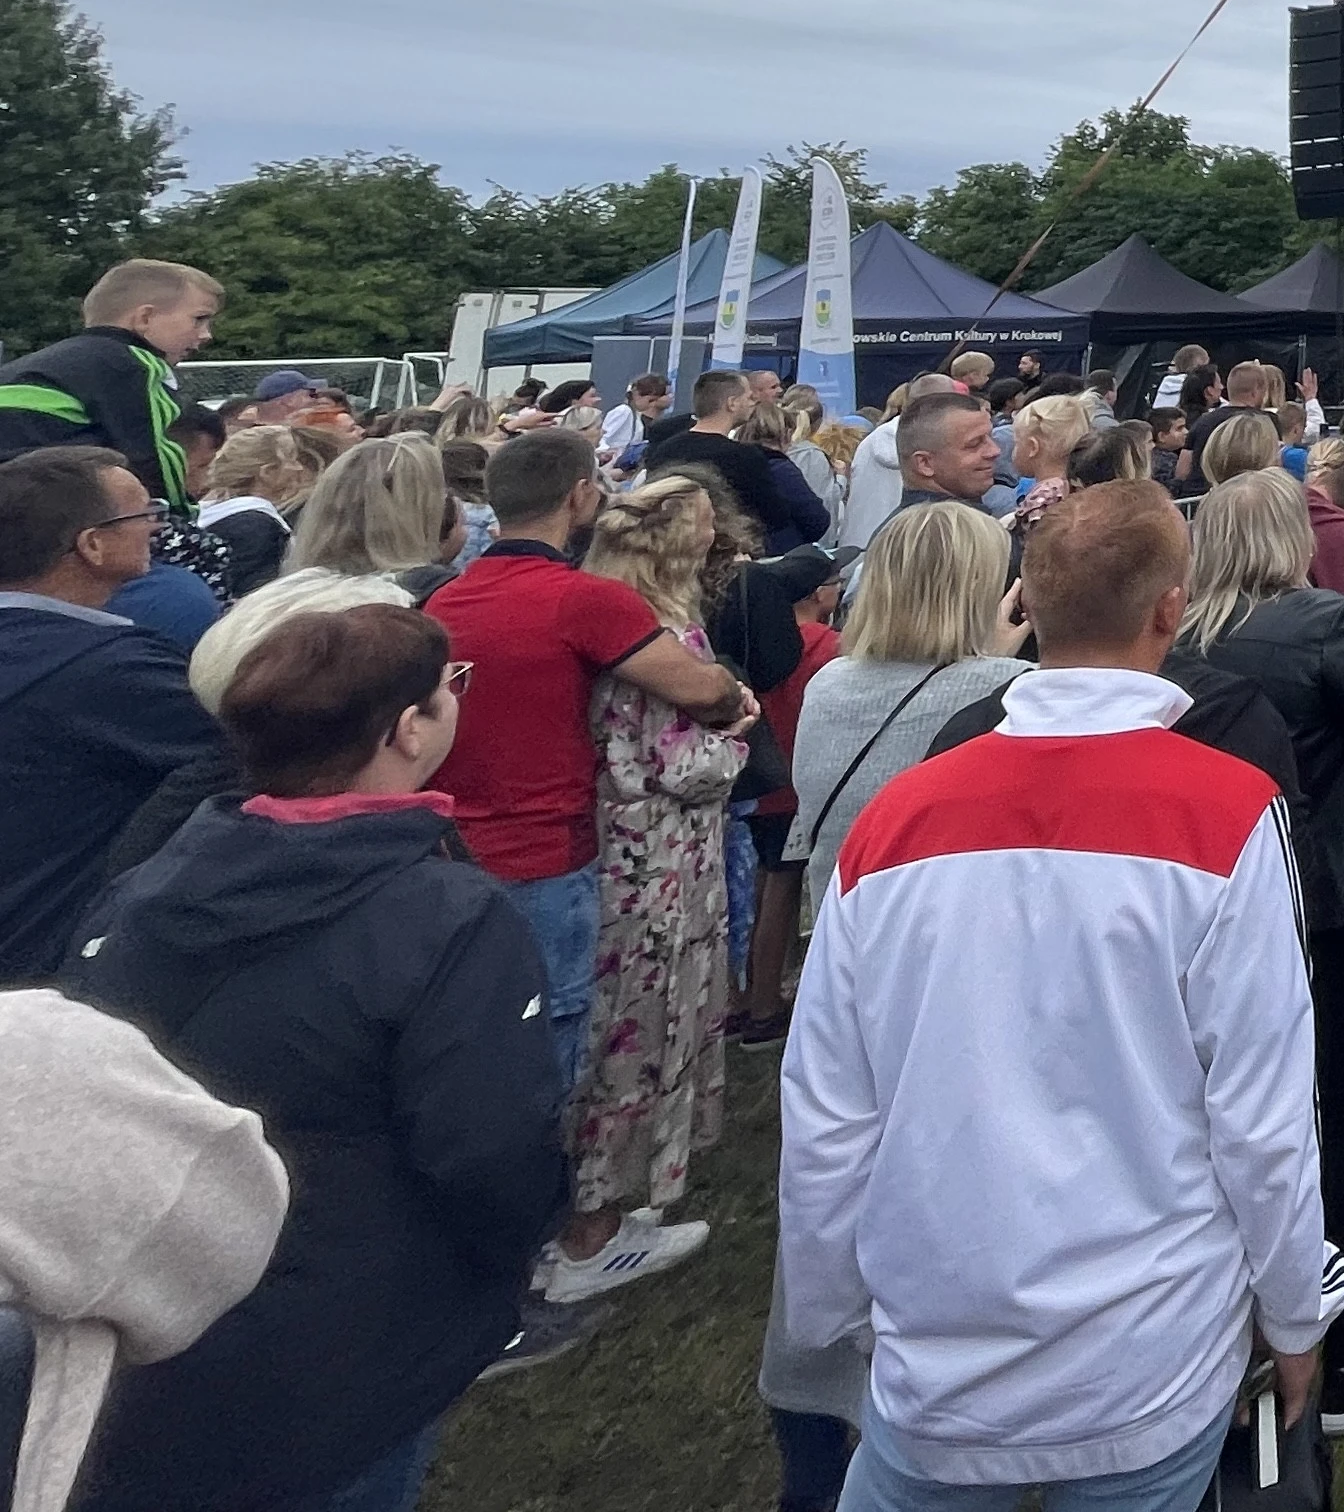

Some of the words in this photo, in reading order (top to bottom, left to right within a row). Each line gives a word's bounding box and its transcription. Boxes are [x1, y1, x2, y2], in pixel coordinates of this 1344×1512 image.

[853, 331, 897, 343] owskie
[900, 330, 953, 342] Centrum
[1000, 332, 1010, 341] w
